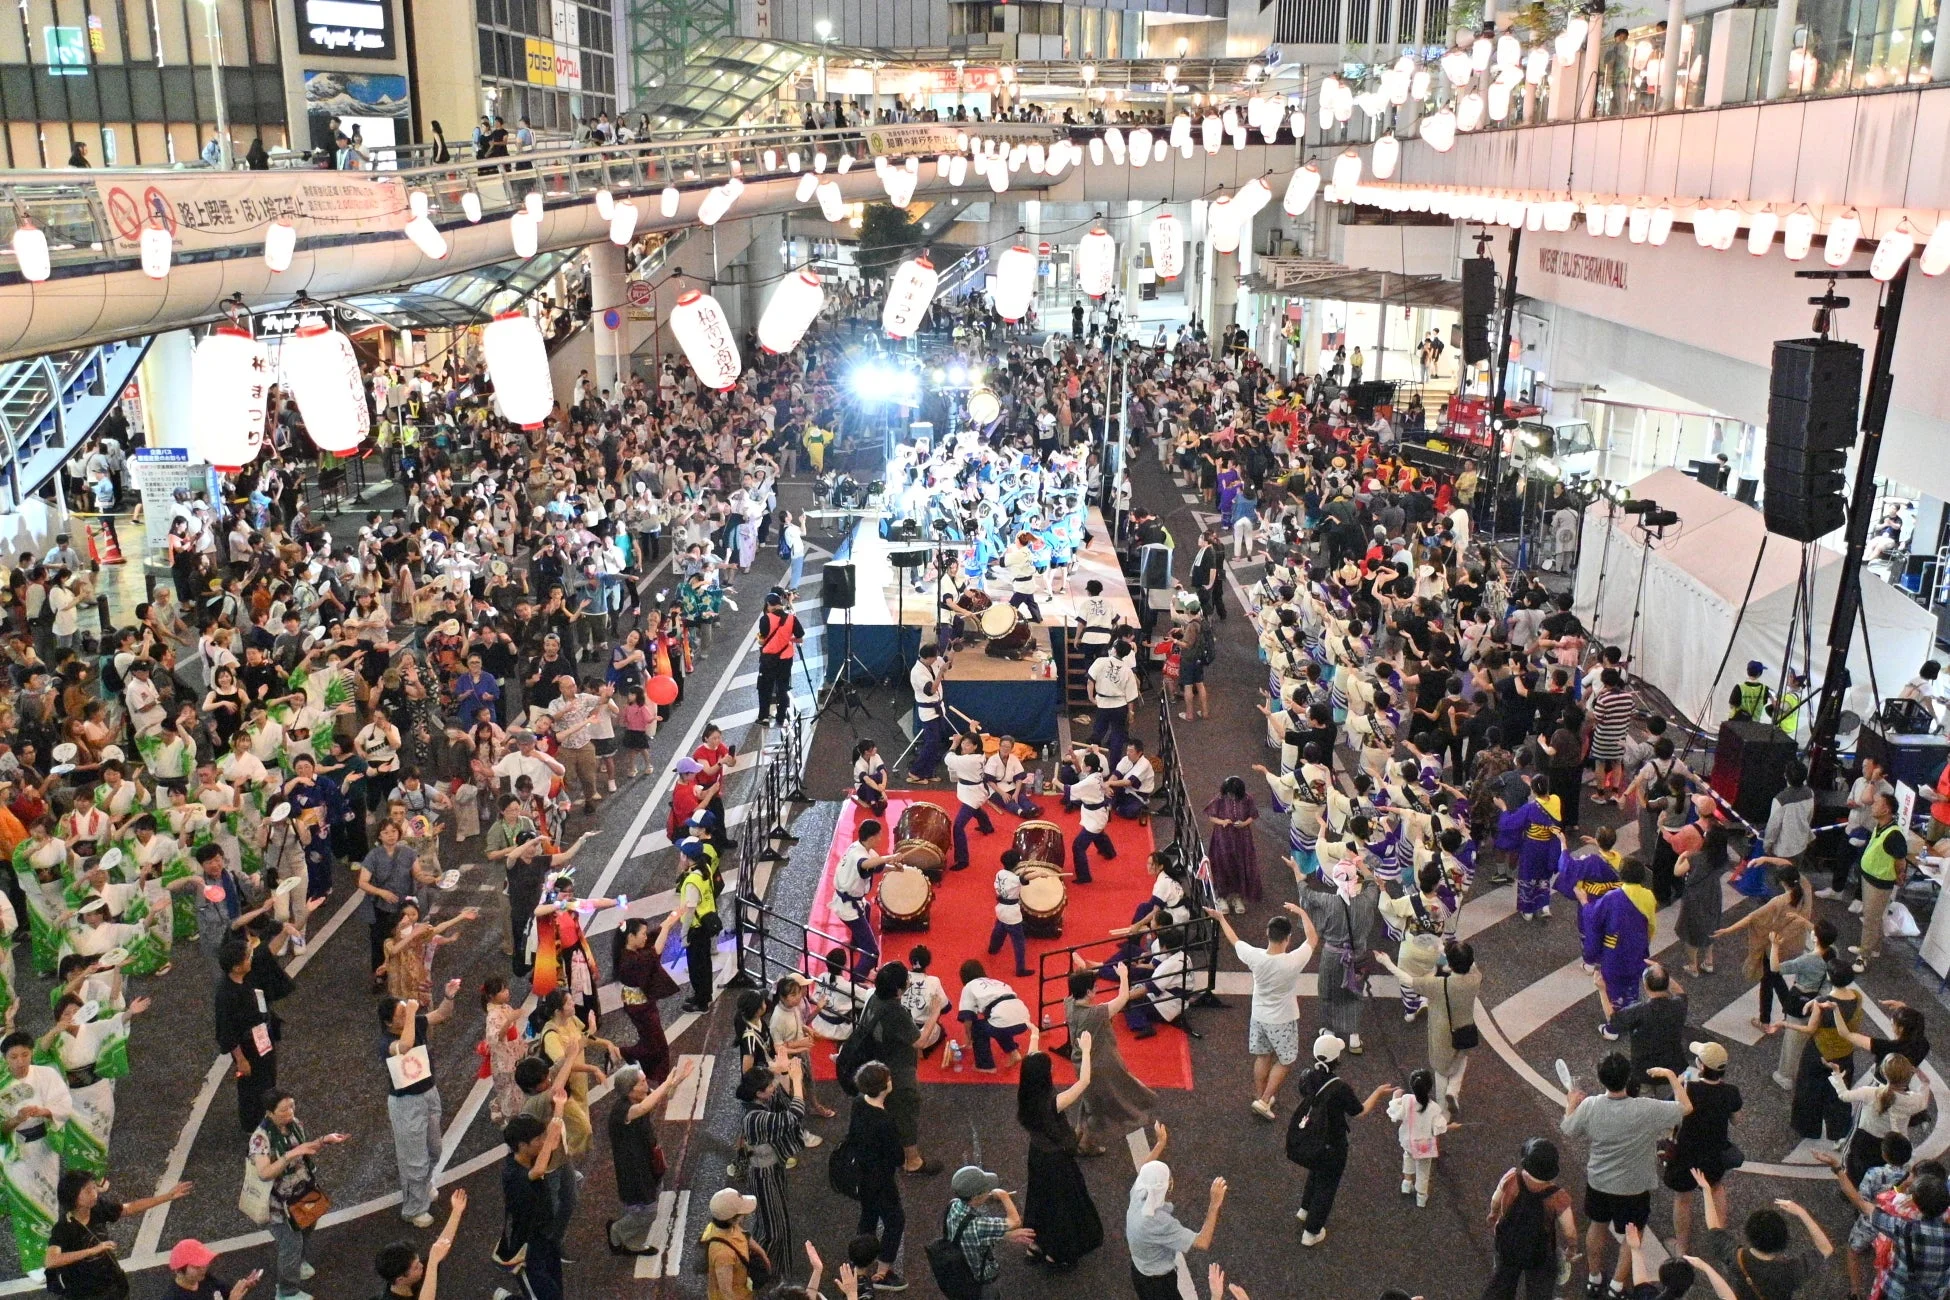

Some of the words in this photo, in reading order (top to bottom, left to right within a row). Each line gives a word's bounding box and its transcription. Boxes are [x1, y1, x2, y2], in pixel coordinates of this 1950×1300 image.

[528, 52, 553, 73] プロミス
[248, 355, 267, 446] 柏まつり
